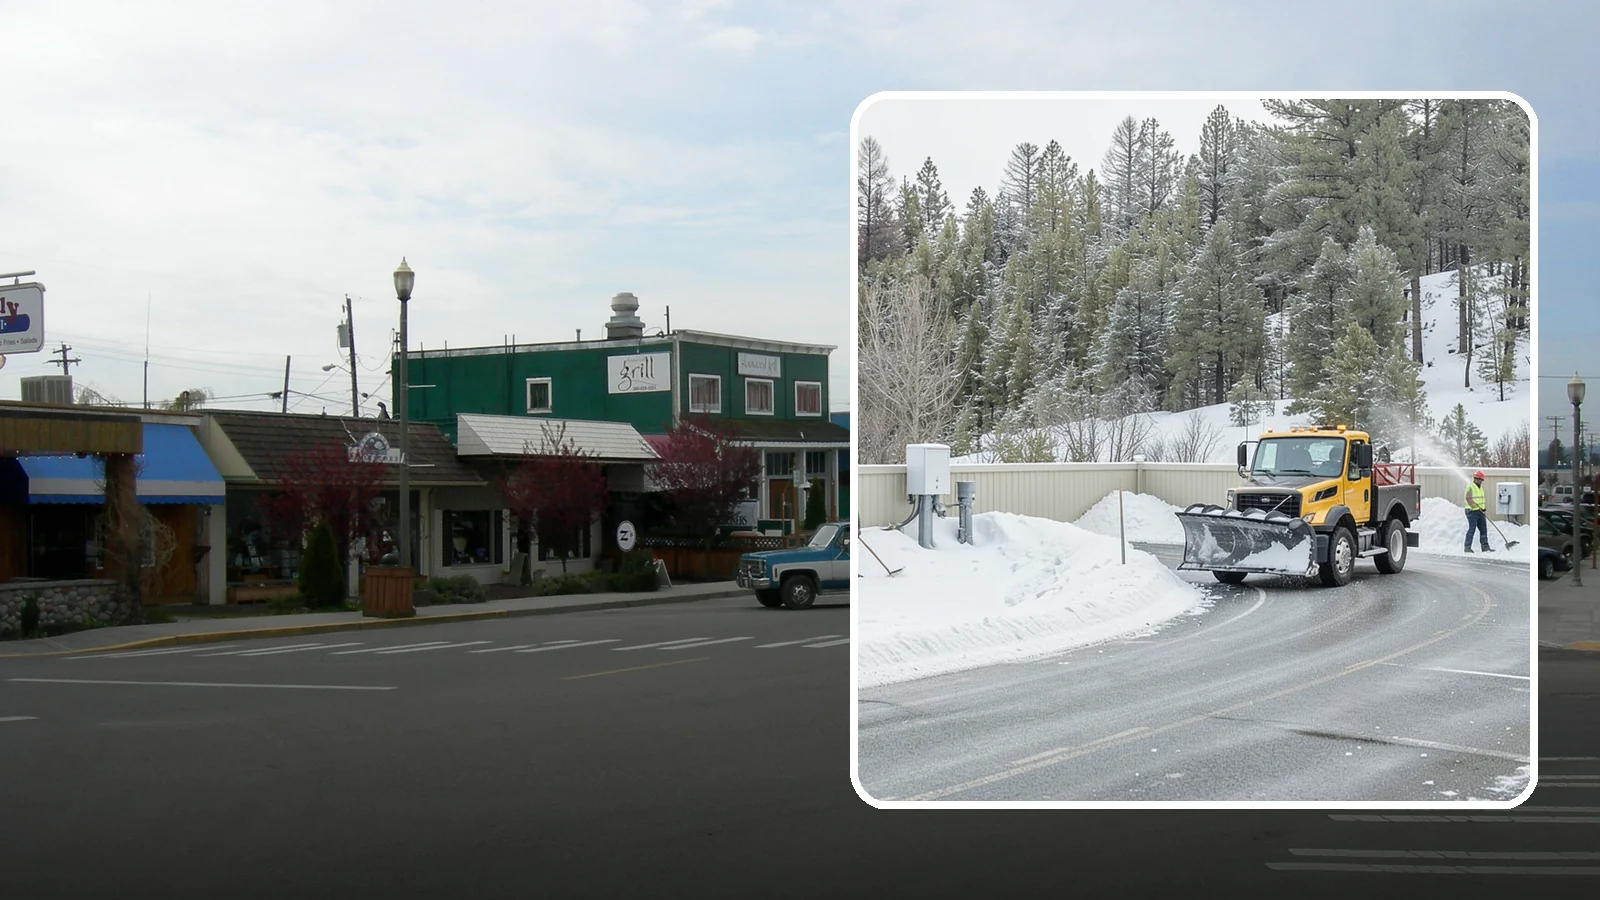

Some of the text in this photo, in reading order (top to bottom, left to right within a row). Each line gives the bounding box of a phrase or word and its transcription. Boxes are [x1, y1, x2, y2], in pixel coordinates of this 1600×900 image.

[3, 337, 38, 346] Fries Salads
[618, 356, 655, 391] grill
